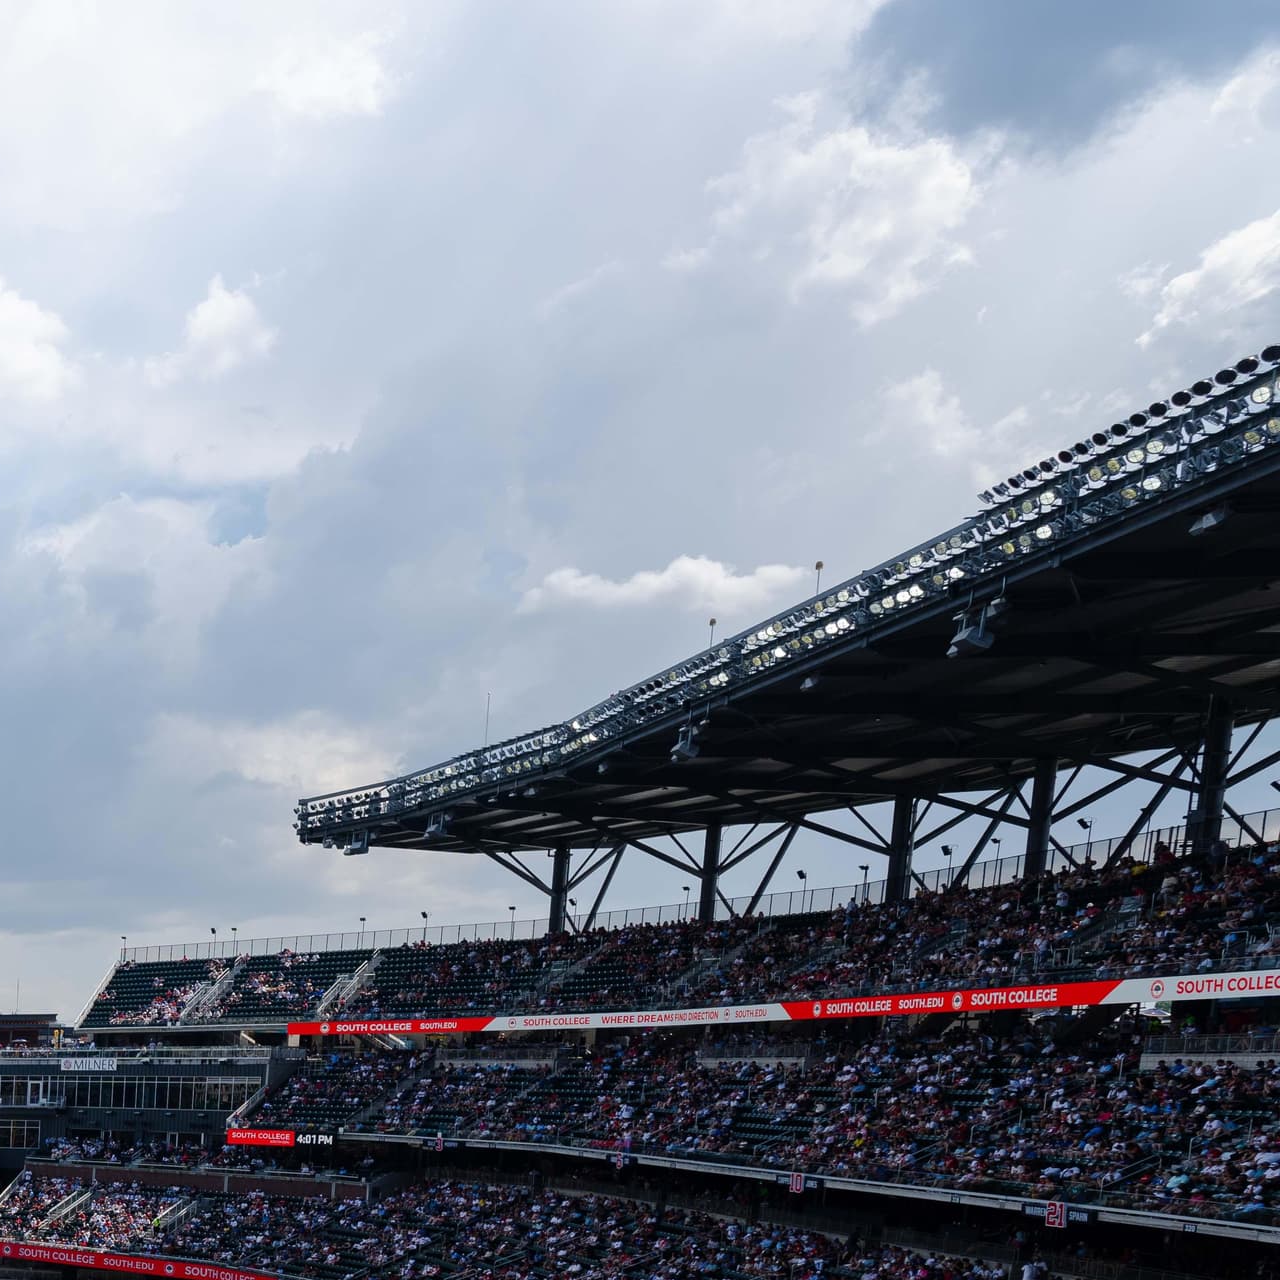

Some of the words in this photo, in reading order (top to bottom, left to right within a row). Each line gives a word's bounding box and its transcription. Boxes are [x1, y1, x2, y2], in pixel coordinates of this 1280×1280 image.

[1176, 978, 1224, 995] SOUTH
[826, 1001, 853, 1014] SOUTH
[854, 999, 892, 1013] COLLEGE
[898, 997, 945, 1009] SOUTH.EDU
[970, 991, 1006, 1006] SOUTH
[1008, 988, 1058, 1004] COLLEGE
[336, 1023, 368, 1033] SOUTH
[370, 1022, 412, 1032] COLLEGE
[523, 1017, 552, 1027] SOUTH
[553, 1016, 591, 1026] COLLEGE
[600, 1014, 635, 1024] WHERE
[637, 1013, 674, 1023] DREAMS
[74, 1058, 115, 1071] MILNER
[231, 1131, 256, 1140] SOUTH
[257, 1132, 291, 1141] COLLEGE
[296, 1133, 316, 1145] 4:01
[316, 1134, 333, 1146] PM
[790, 1173, 804, 1194] 10
[1045, 1201, 1067, 1228] 21
[18, 1247, 51, 1260] SOUTH
[52, 1251, 95, 1265] COLLEGE
[103, 1257, 155, 1271] SOUTH.EDU
[184, 1265, 220, 1280] SOUTH
